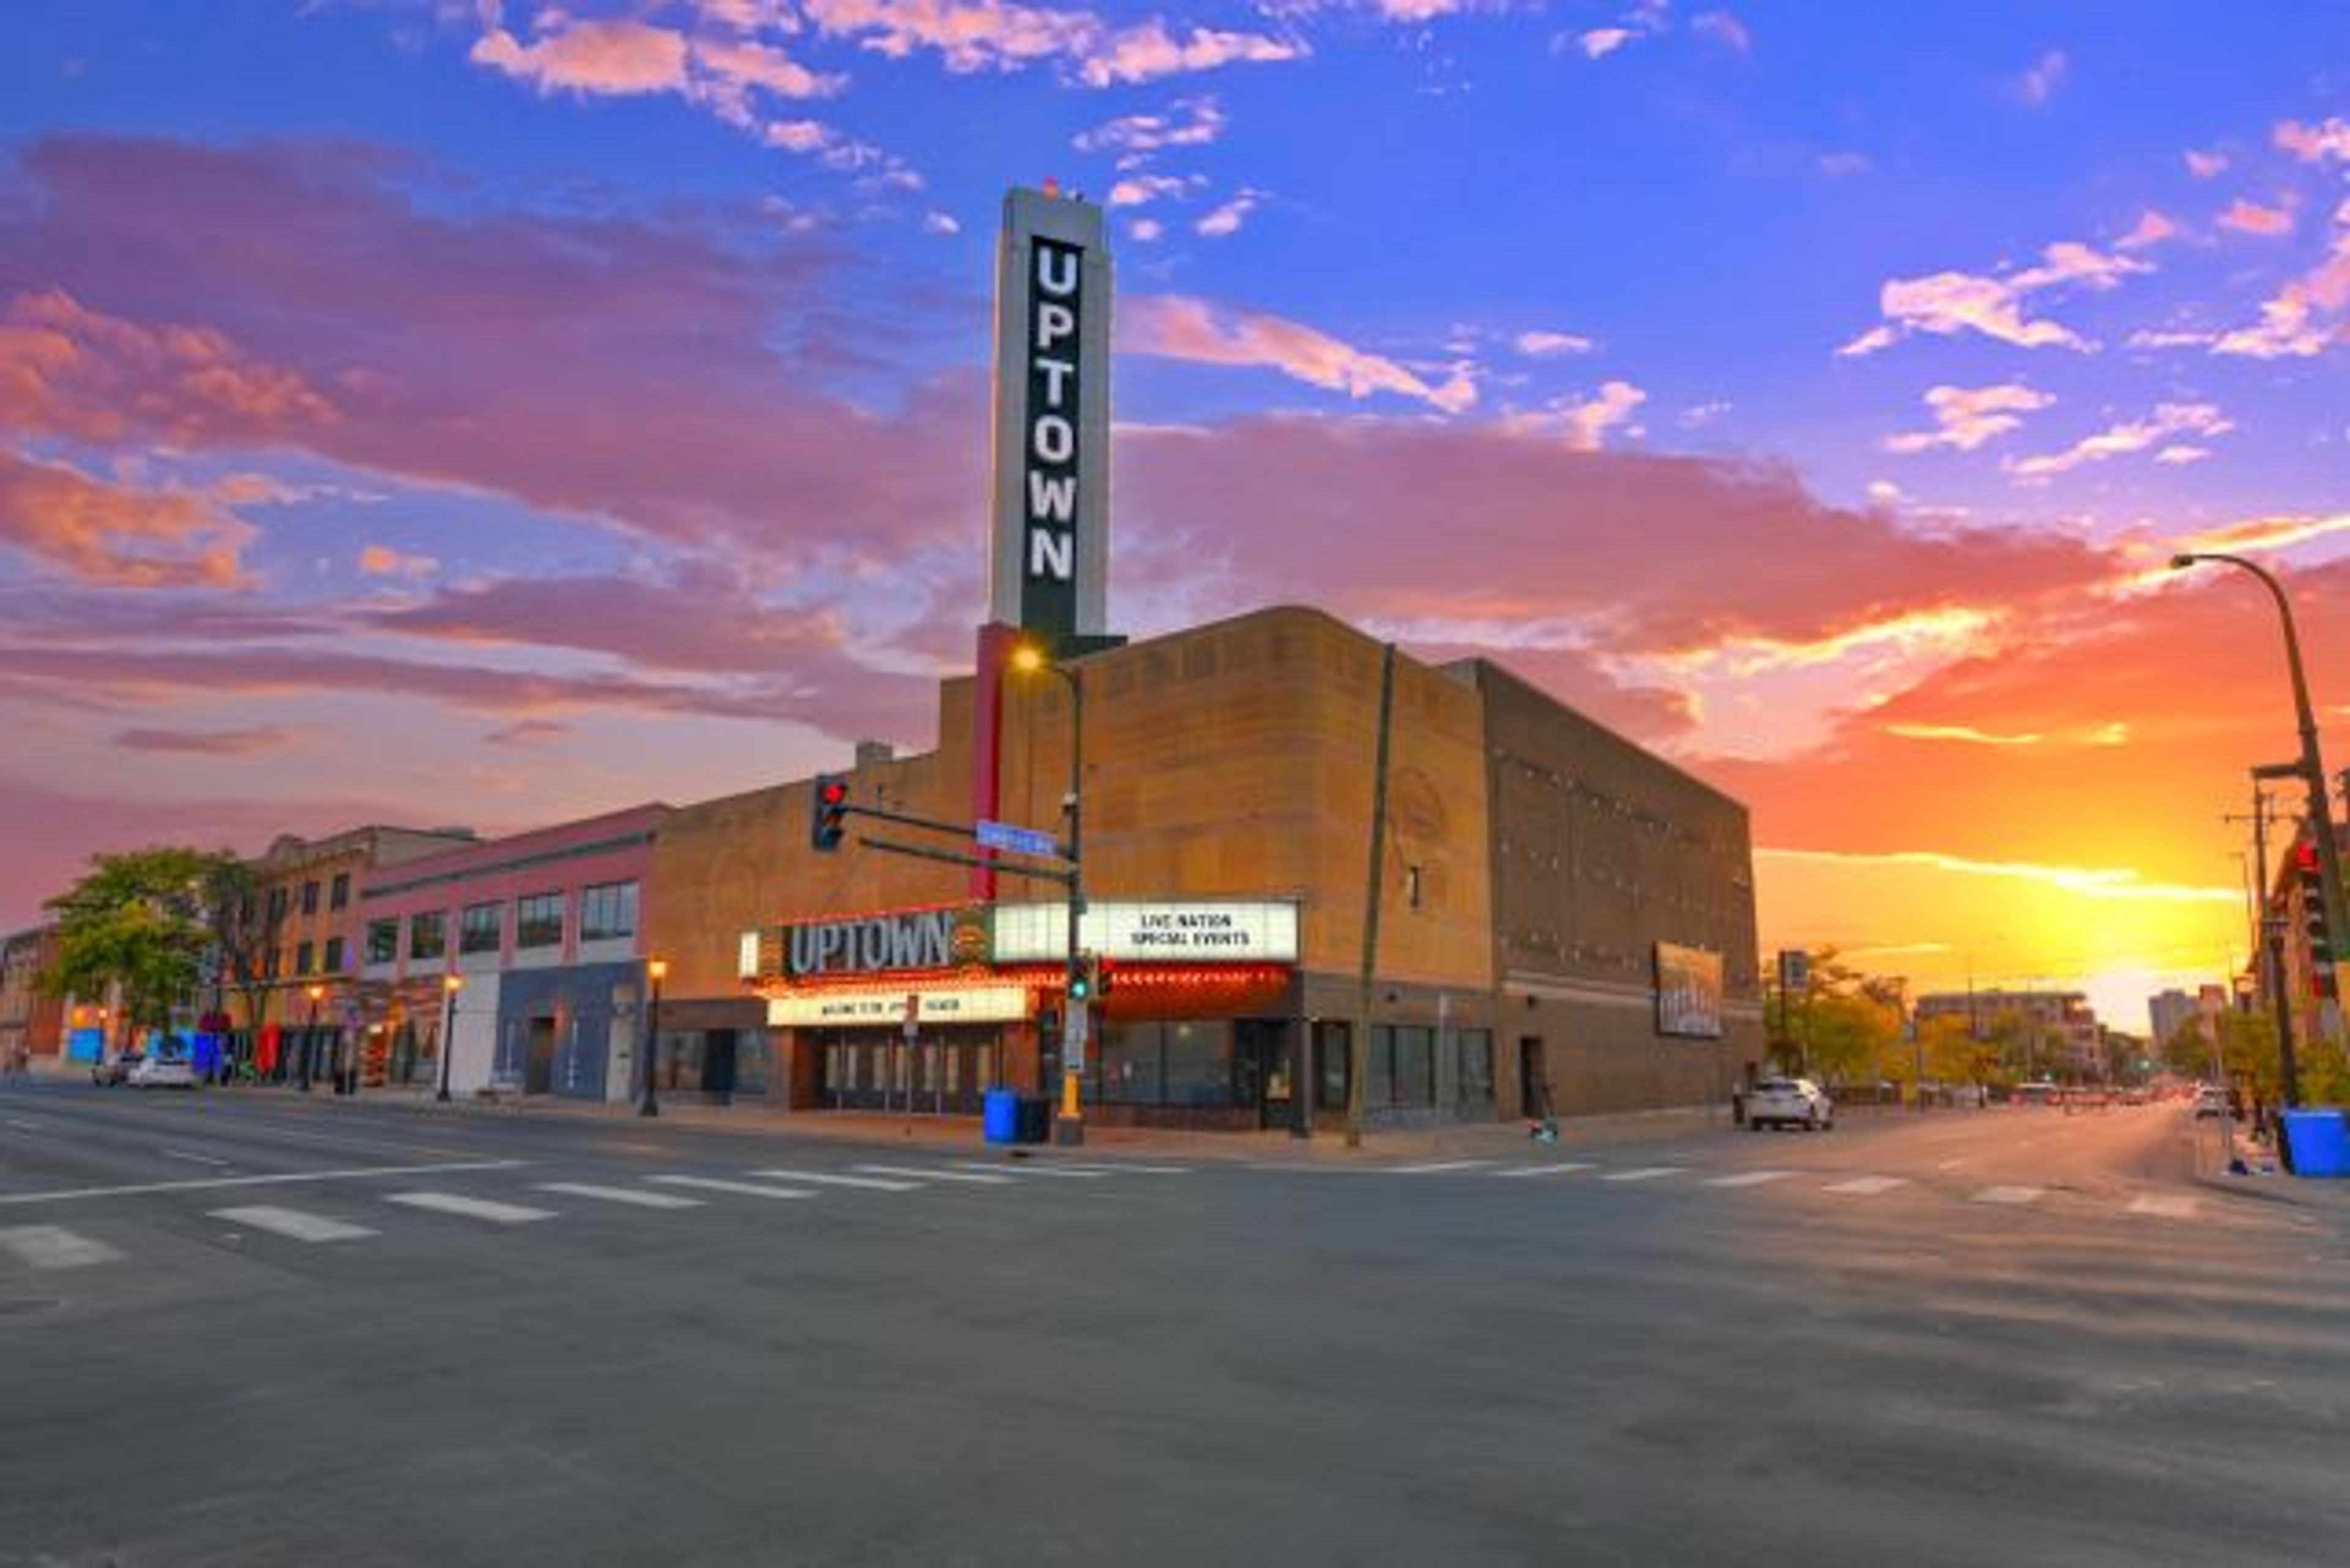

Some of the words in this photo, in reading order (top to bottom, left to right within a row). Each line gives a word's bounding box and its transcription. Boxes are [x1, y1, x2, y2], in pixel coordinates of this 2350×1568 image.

[1029, 244, 1078, 579] UPTOWN
[1130, 931, 1187, 946] SPECIAL
[1193, 931, 1250, 946] EVENTS
[1141, 914, 1171, 928] LIVE
[1178, 913, 1231, 927] NATION
[791, 909, 953, 973] UPTOWN
